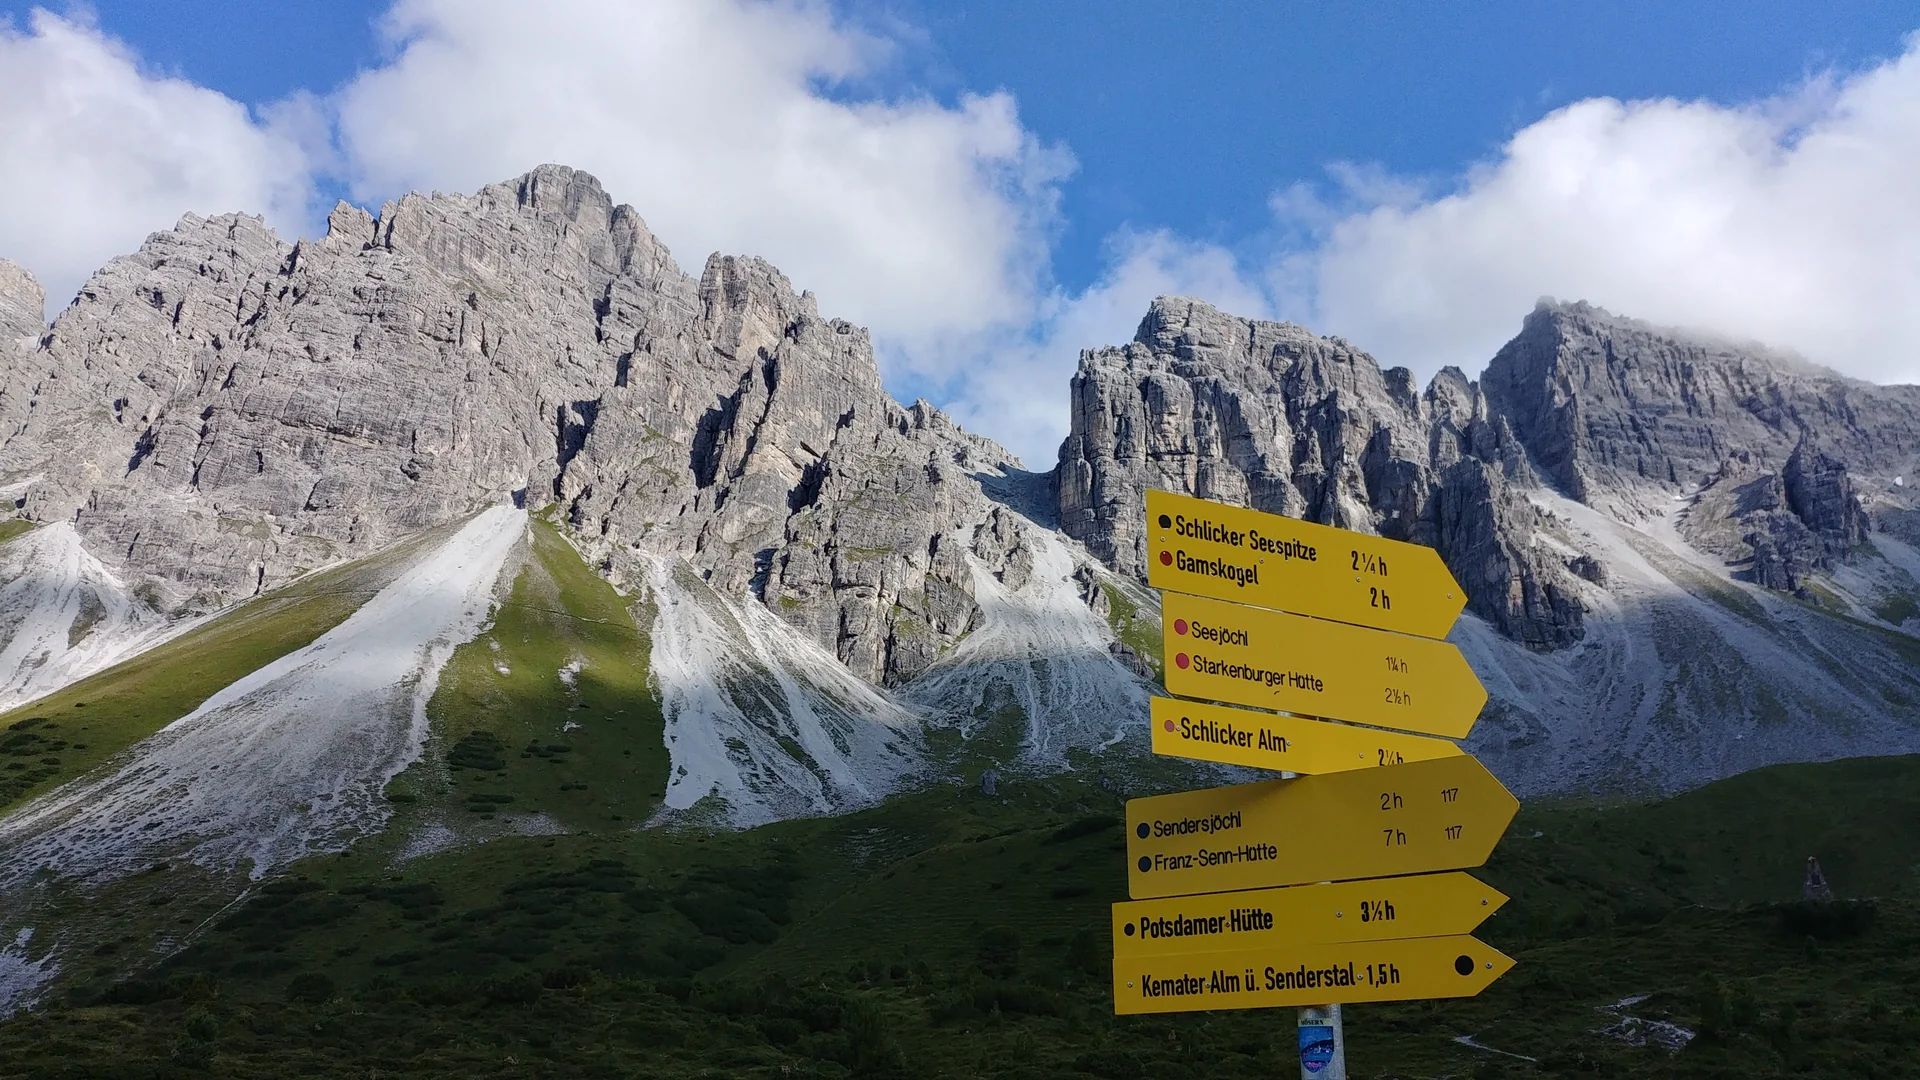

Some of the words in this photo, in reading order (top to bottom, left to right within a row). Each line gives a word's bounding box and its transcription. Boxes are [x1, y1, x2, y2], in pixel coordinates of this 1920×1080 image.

[1175, 514, 1245, 547] Schlicker
[1249, 529, 1317, 562] Seespitze
[1176, 549, 1259, 588] Gamskogel
[1191, 621, 1249, 647] Seejöchl
[1193, 654, 1286, 687] Starkenburger
[1180, 716, 1254, 748] Schlicker
[1258, 728, 1287, 753] Alm
[1153, 810, 1242, 838] Sendersjöchl
[1441, 788, 1459, 803] 117
[1444, 825, 1463, 840] 117
[1140, 913, 1225, 940] Potsdamer
[1230, 909, 1273, 932] Hütte
[1141, 973, 1206, 998] Kemater
[1210, 968, 1240, 994] Alm
[1245, 967, 1260, 991] ü.
[1265, 961, 1356, 990] Senderstal
